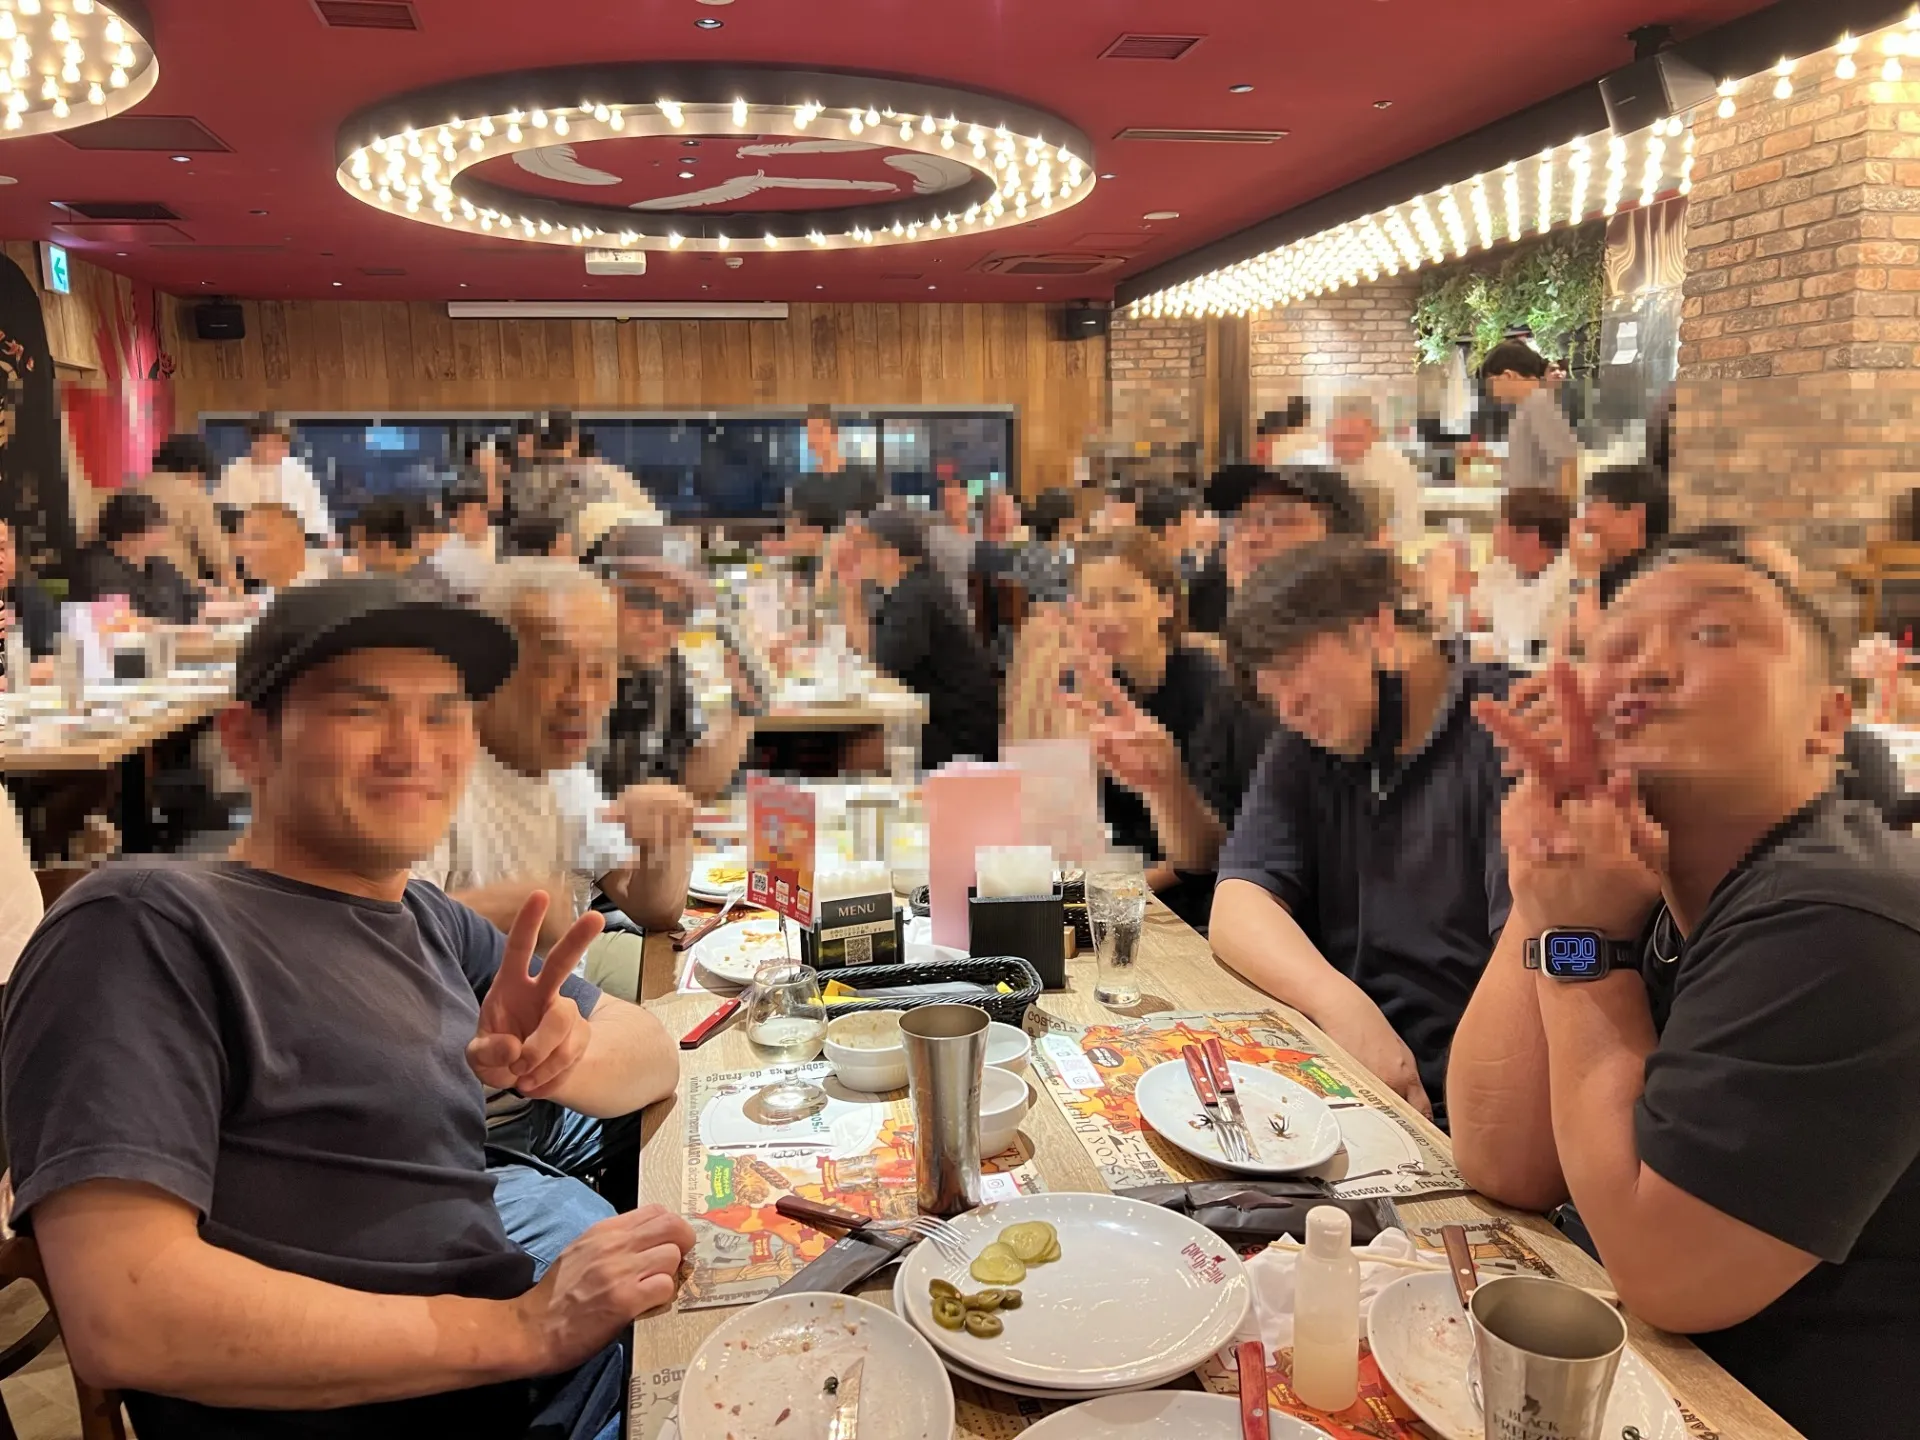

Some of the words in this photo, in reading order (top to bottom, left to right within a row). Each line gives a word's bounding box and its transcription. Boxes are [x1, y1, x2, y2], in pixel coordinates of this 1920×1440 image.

[838, 902, 876, 918] MENU
[1027, 1010, 1079, 1034] costela
[706, 1072, 742, 1083] frango
[1358, 1086, 1400, 1121] LAGARTO
[688, 1134, 701, 1166] LAGARTO
[630, 1375, 647, 1410] vinho
[1508, 1408, 1560, 1432] BLACK
